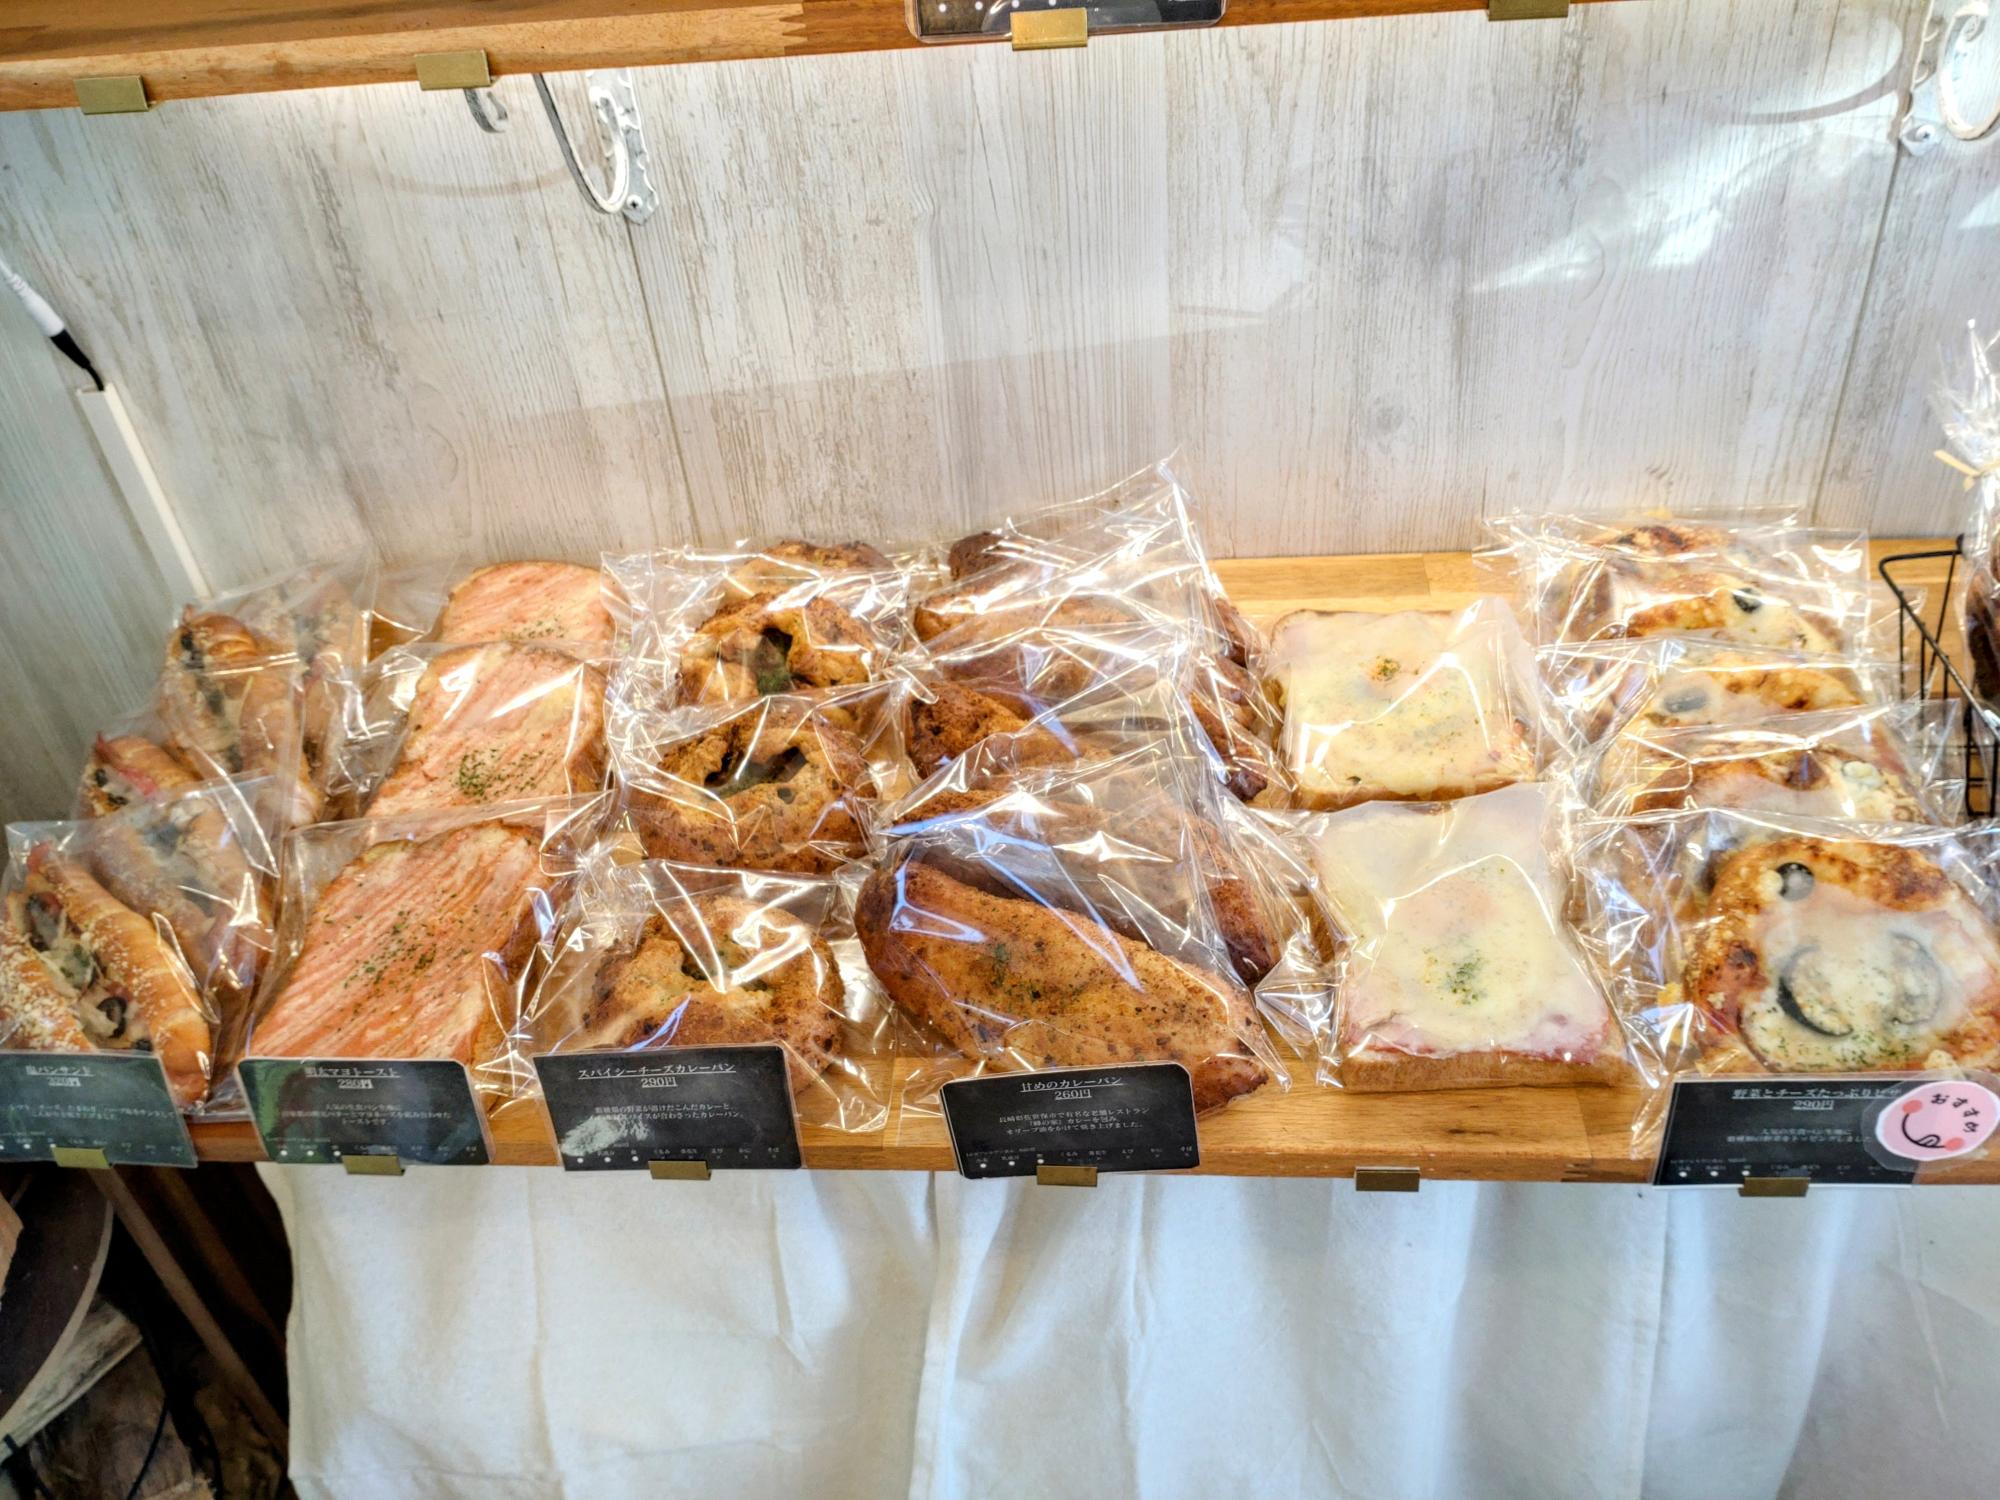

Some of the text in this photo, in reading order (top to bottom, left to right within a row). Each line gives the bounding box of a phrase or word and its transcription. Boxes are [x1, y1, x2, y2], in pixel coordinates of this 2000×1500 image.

[578, 1063, 737, 1079] スパイシーチーズカレーパン
[641, 1076, 678, 1088] 290円
[1021, 1077, 1123, 1092] 甘めのカレーパン
[1054, 1088, 1093, 1101] 260円
[1931, 1094, 1980, 1133] おすすめ
